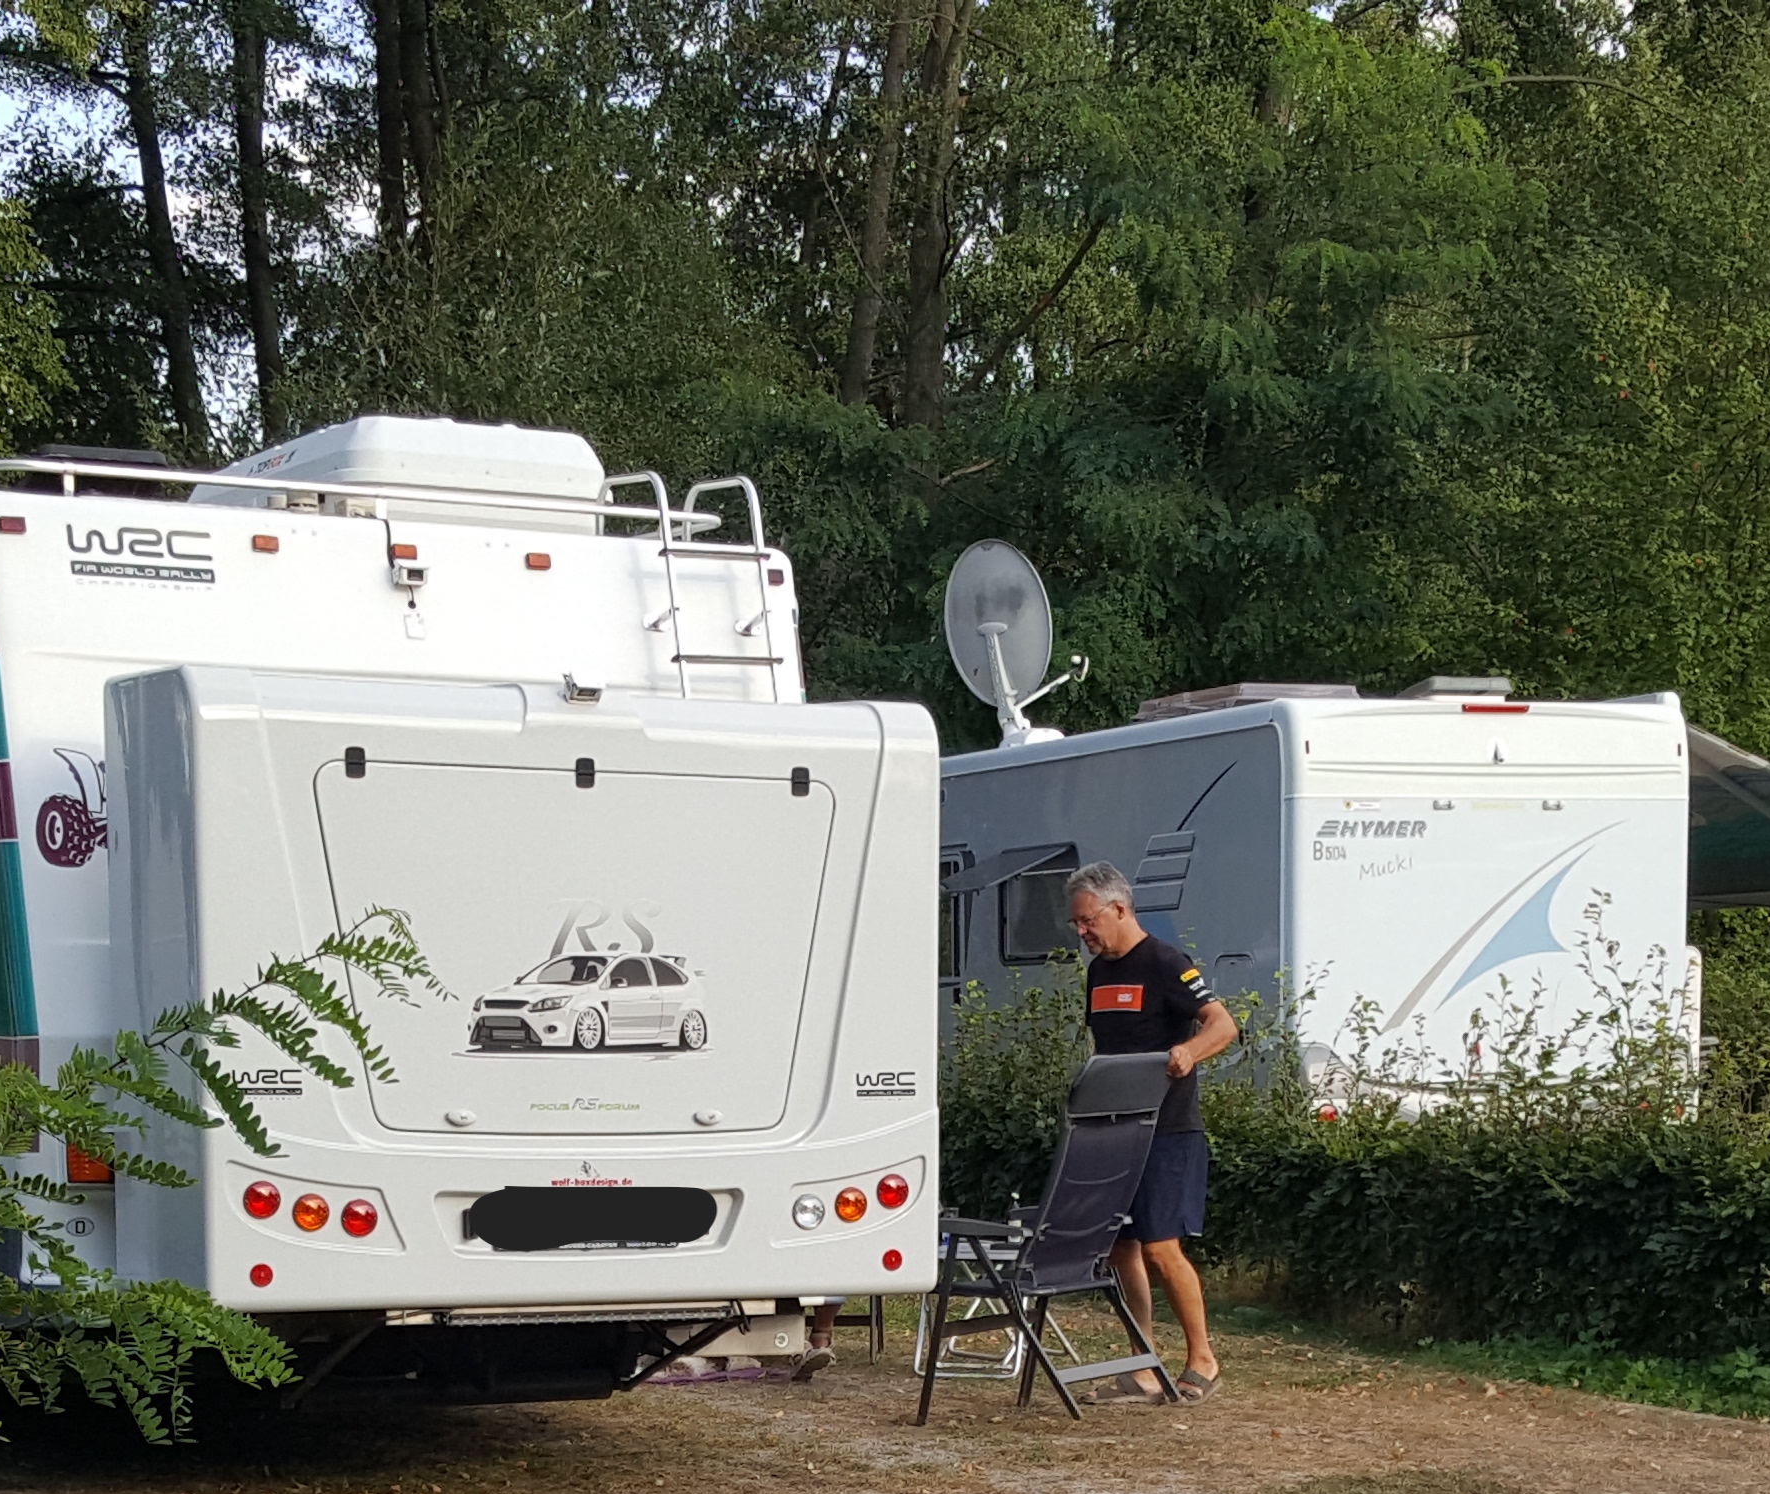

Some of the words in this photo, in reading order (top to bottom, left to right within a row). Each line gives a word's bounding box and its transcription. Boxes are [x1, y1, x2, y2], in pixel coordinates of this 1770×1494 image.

[66, 524, 213, 561] WRC
[73, 563, 98, 573] FIA
[100, 565, 156, 577] WORLD
[159, 569, 212, 580] RALLY
[1339, 820, 1427, 838] HYMER
[232, 1069, 302, 1084] WRC
[856, 1072, 916, 1087] WRC
[598, 1103, 640, 1111] FORUM
